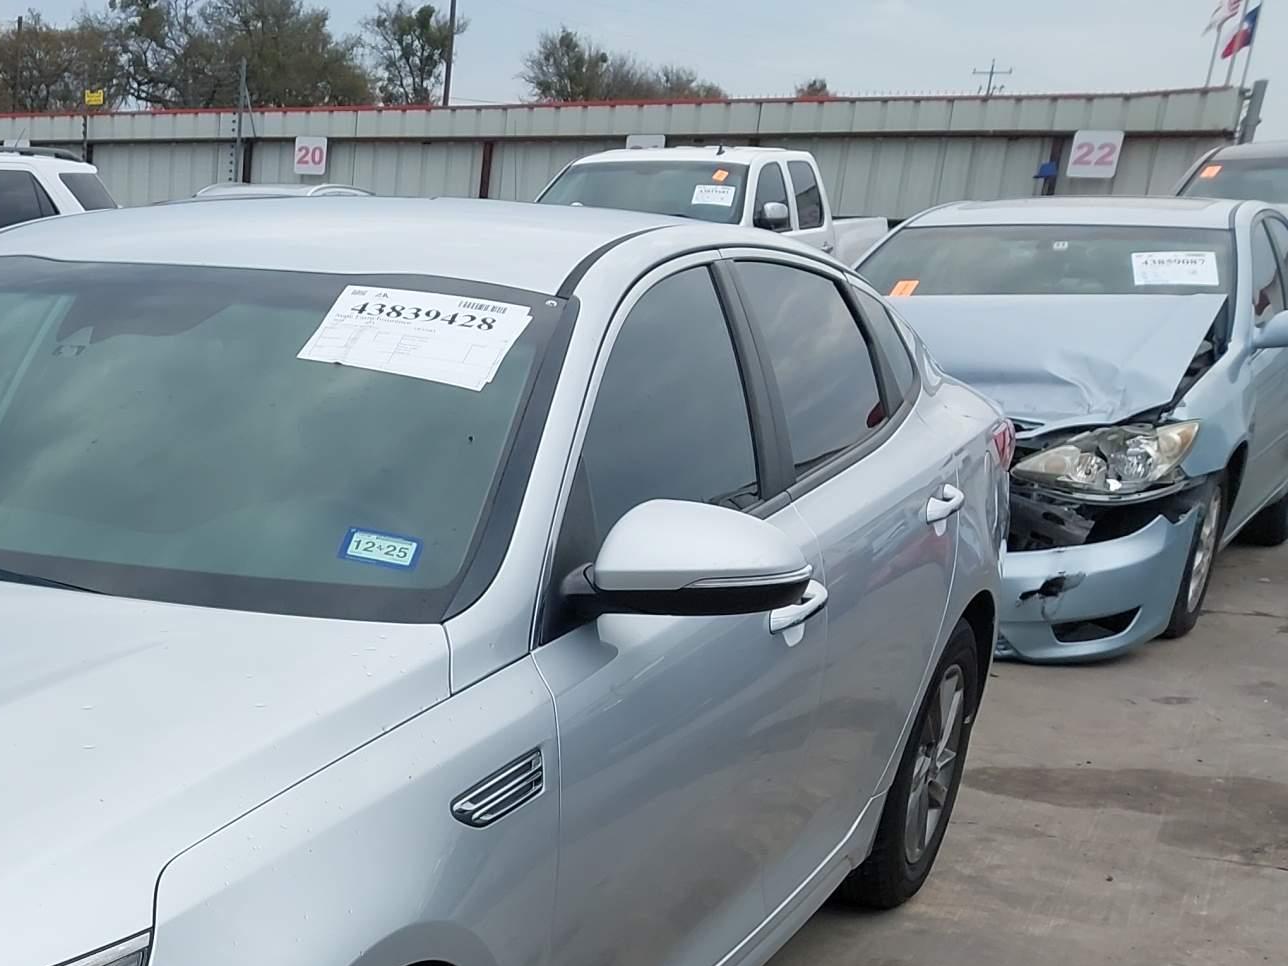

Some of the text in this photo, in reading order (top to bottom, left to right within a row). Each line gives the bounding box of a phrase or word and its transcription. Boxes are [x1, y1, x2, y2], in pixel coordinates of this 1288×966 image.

[296, 145, 324, 166] 20
[1072, 142, 1117, 166] 22
[351, 301, 497, 331] 43839428
